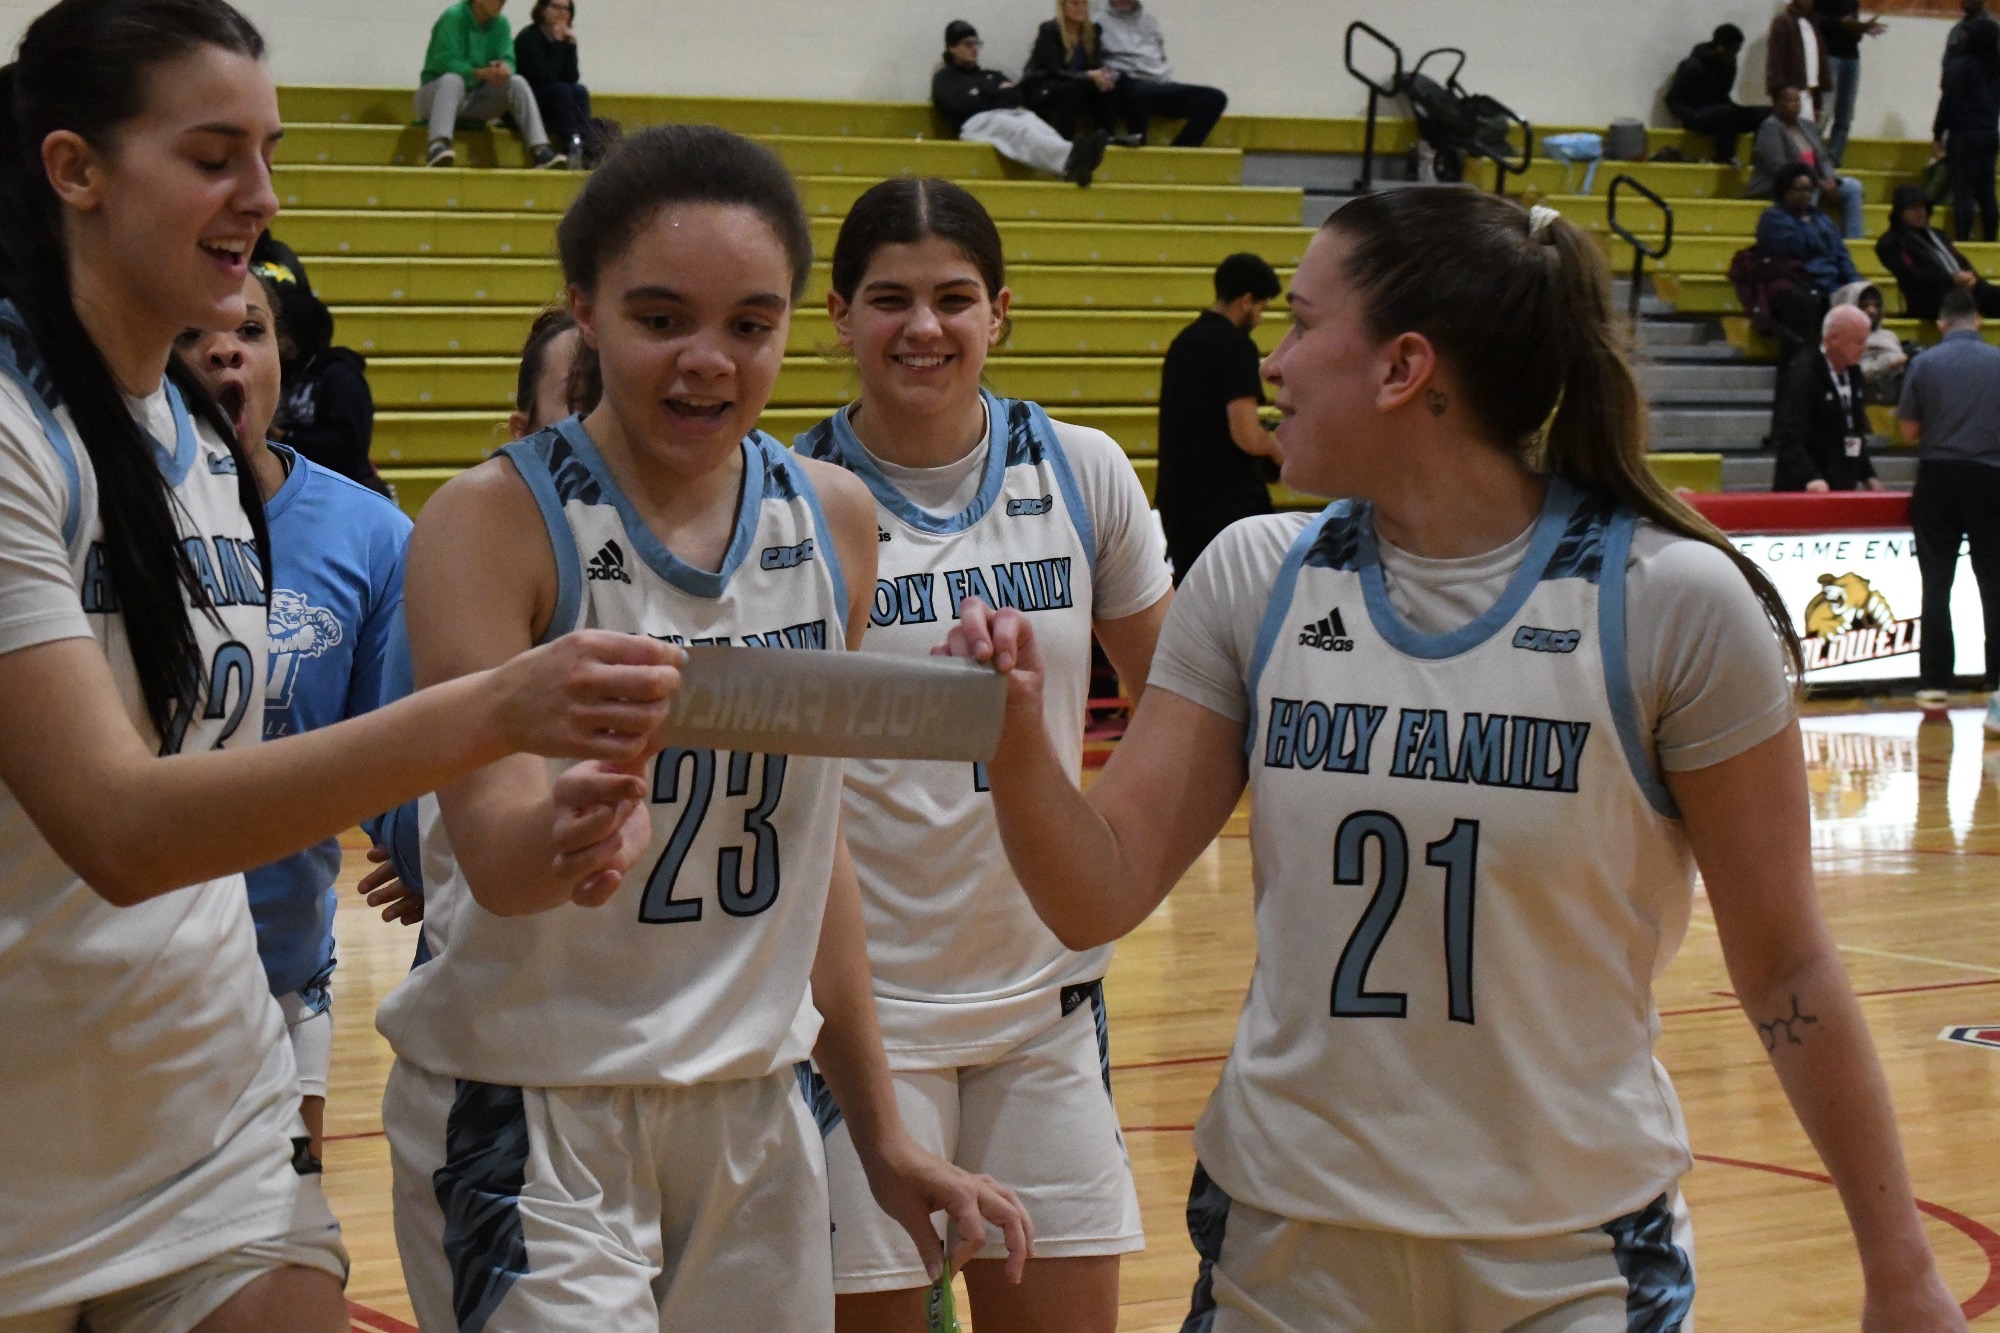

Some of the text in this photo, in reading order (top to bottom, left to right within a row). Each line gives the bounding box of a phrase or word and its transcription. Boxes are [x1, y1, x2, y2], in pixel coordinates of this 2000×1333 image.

[1006, 494, 1053, 517] CACC
[1768, 541, 1851, 561] GAME
[867, 556, 1074, 627] OLY FAMILY
[1298, 632, 1354, 652] adidas
[1265, 697, 1591, 793] HOLY FAMILY
[638, 746, 788, 924] 23
[1330, 810, 1479, 1025] 21
